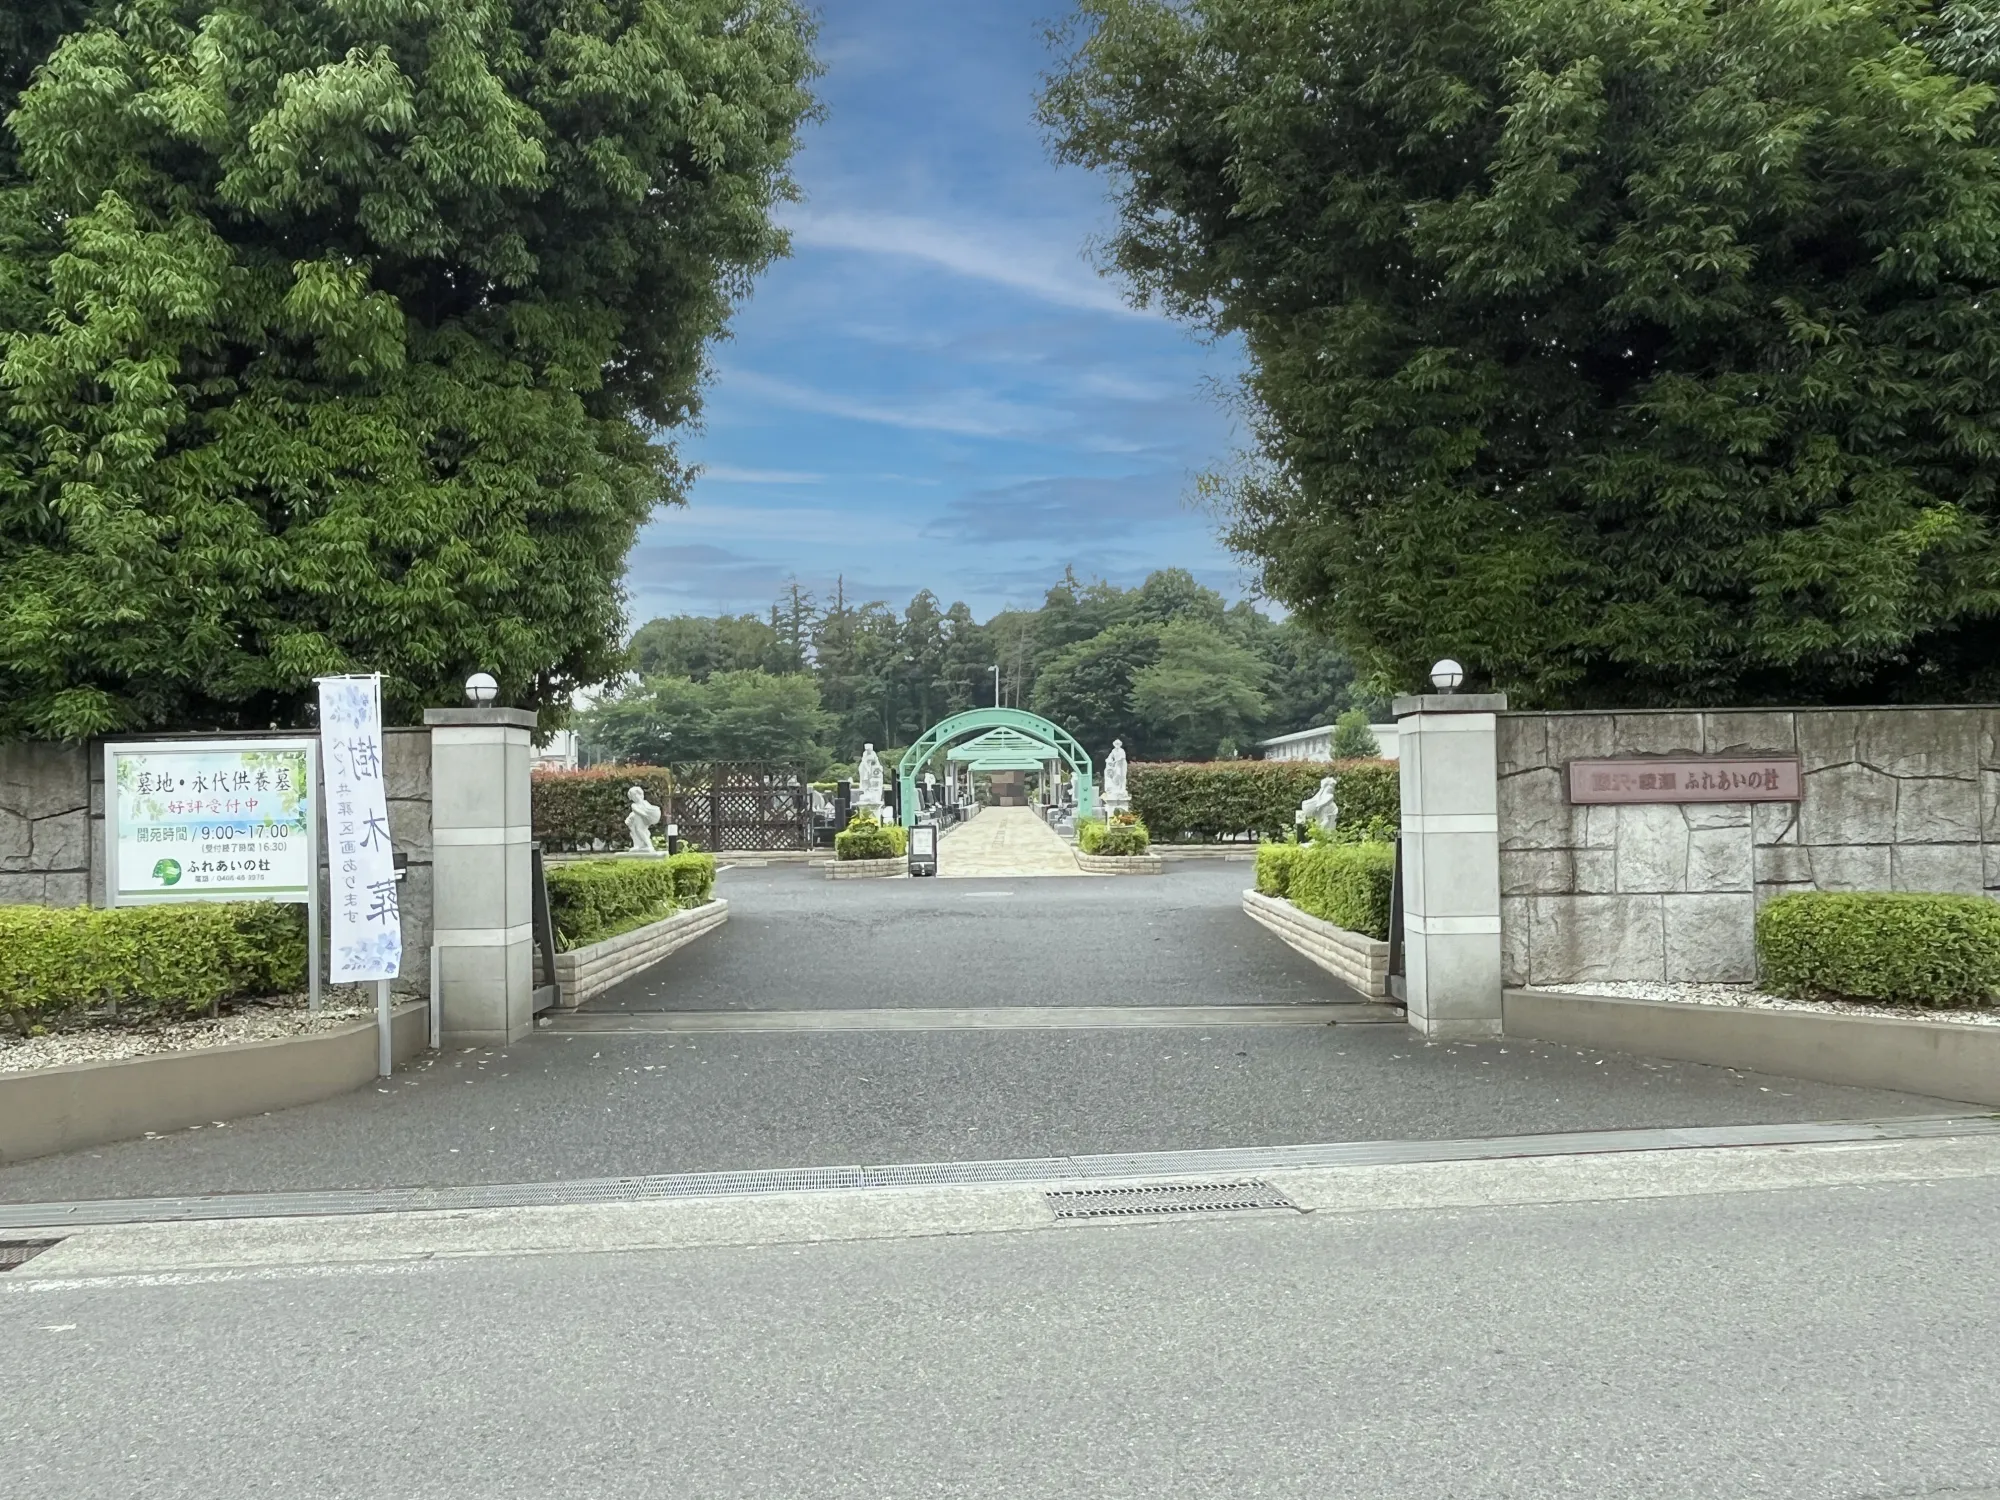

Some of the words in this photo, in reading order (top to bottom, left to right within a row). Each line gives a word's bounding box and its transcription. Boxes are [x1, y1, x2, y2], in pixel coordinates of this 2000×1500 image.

[136, 768, 291, 795] 墓地・永代供養墓
[1685, 768, 1779, 791] ふれあいの杜
[168, 798, 259, 814] 好評受付中
[187, 858, 270, 872] ふれあいの杜
